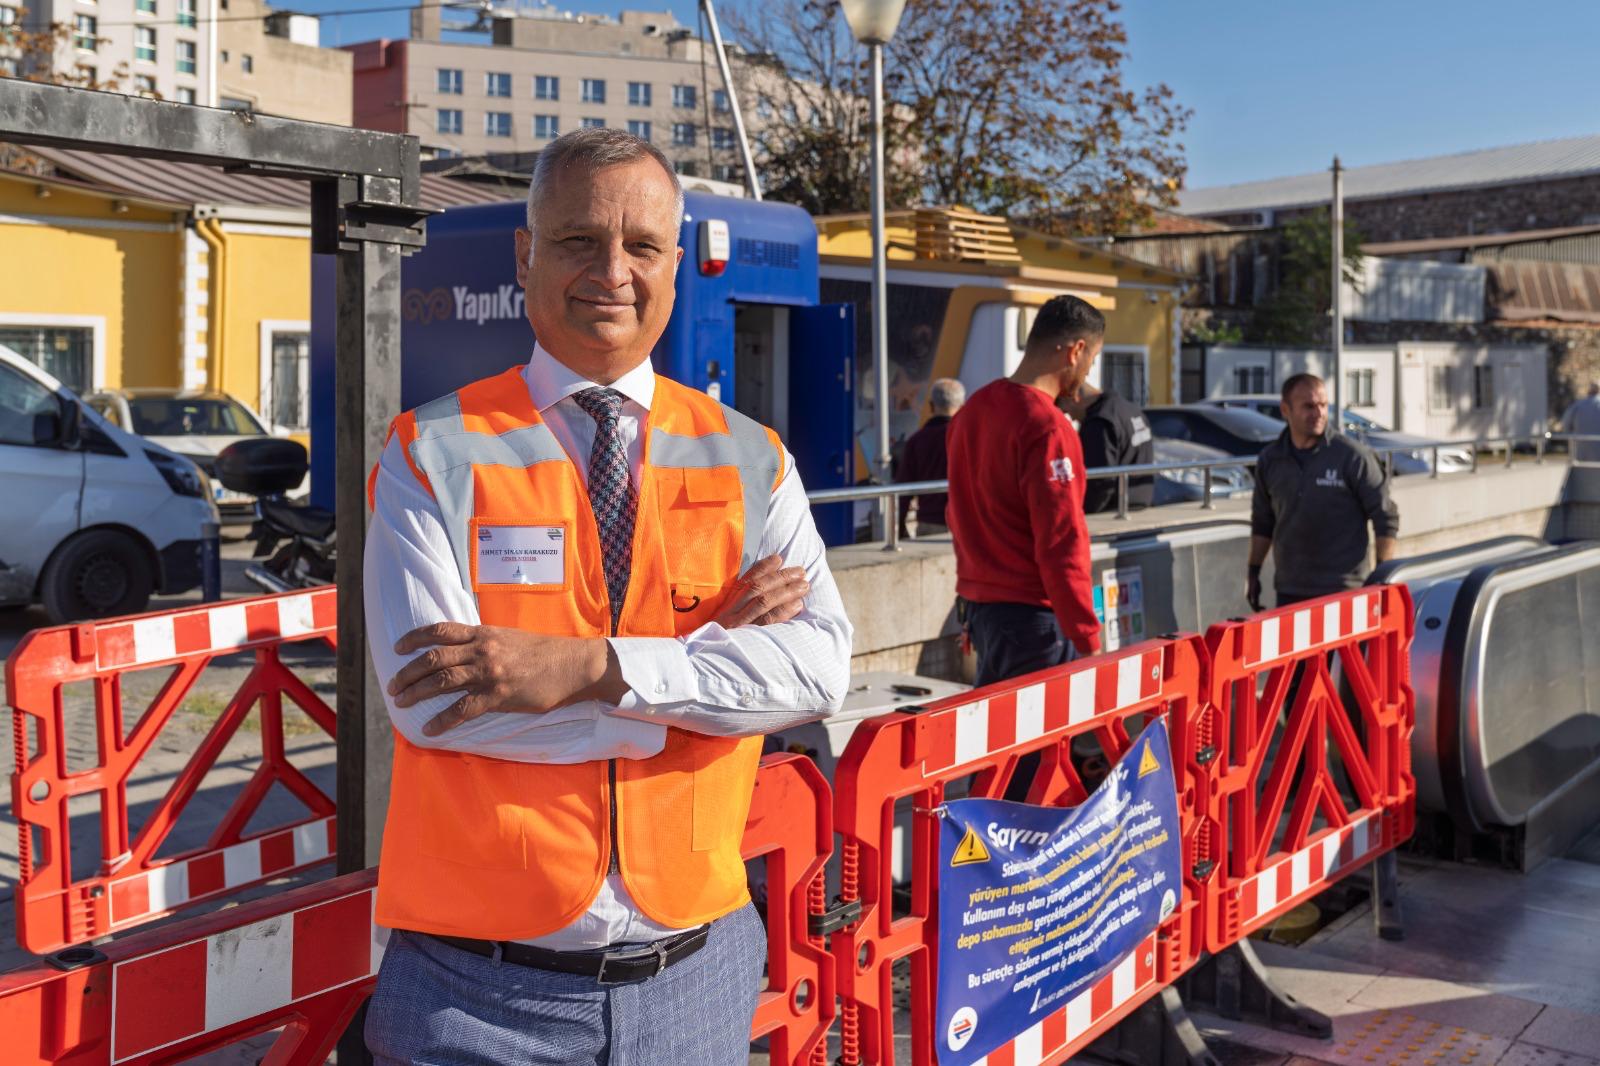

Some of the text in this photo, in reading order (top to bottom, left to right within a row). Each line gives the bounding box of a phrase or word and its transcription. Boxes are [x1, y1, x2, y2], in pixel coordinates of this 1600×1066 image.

[987, 822, 1049, 851] Sayın
[963, 907, 1005, 926] Kullanım
[1008, 901, 1025, 917] dışı
[1027, 896, 1046, 911] olan
[969, 886, 1008, 907] yürüyen
[957, 931, 980, 950] depo
[981, 918, 1033, 941] sahamızda
[1009, 934, 1046, 956] ettiğimiz
[968, 973, 980, 989] Bu
[982, 964, 1014, 984] süreçte
[1015, 953, 1039, 974] sizlere
[1041, 941, 1064, 962] vermiş
[1051, 962, 1060, 973] ve
